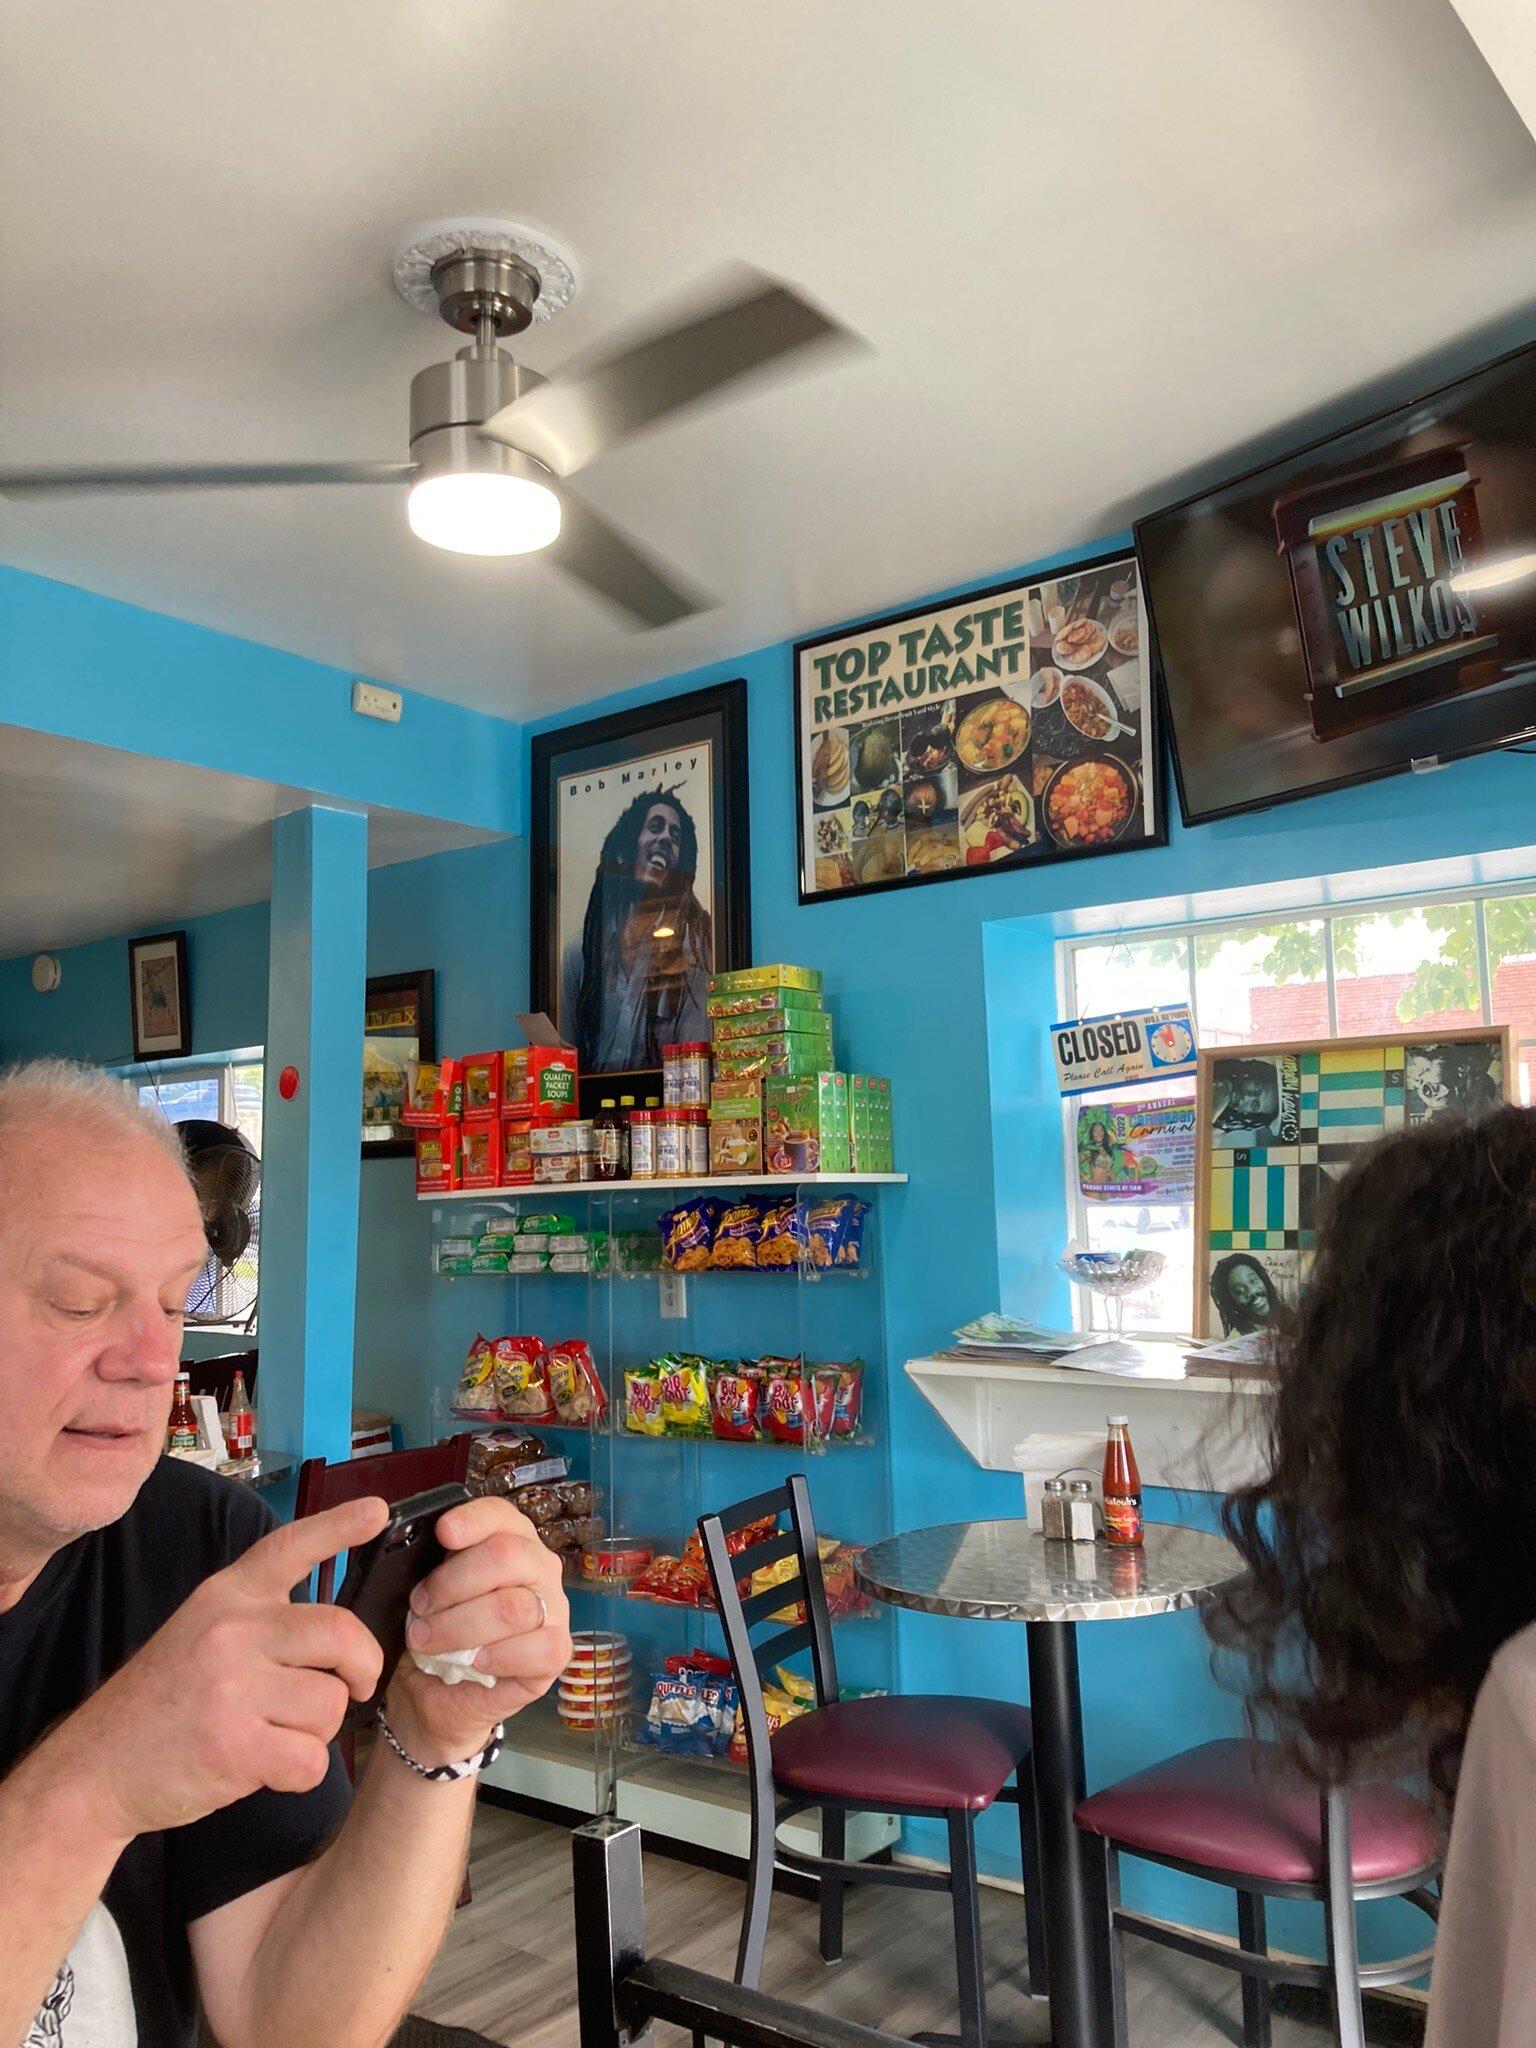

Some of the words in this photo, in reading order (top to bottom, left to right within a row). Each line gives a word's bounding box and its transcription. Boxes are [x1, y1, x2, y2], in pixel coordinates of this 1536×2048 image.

[1325, 499, 1467, 606] STEVE
[1337, 579, 1478, 669] WILKOS
[813, 640, 892, 690] TOP
[899, 600, 1025, 668] TASTE
[814, 642, 1025, 724] RESTAURANT
[569, 780, 606, 796] Bob
[621, 757, 697, 784] Marley
[1057, 1020, 1142, 1066] CLOSED
[543, 1072, 572, 1082] QUALITY
[1063, 1072, 1090, 1083] Please
[1093, 1066, 1114, 1079] Call
[1115, 1063, 1144, 1075] Again
[545, 1082, 570, 1090] PACKET
[547, 1090, 568, 1098] SOUPS
[1147, 1099, 1176, 1111] ANNUAL
[1116, 1115, 1127, 1138] 2022
[631, 1381, 650, 1397] BIG
[661, 1375, 681, 1392] BIG
[722, 1379, 738, 1397] BIG
